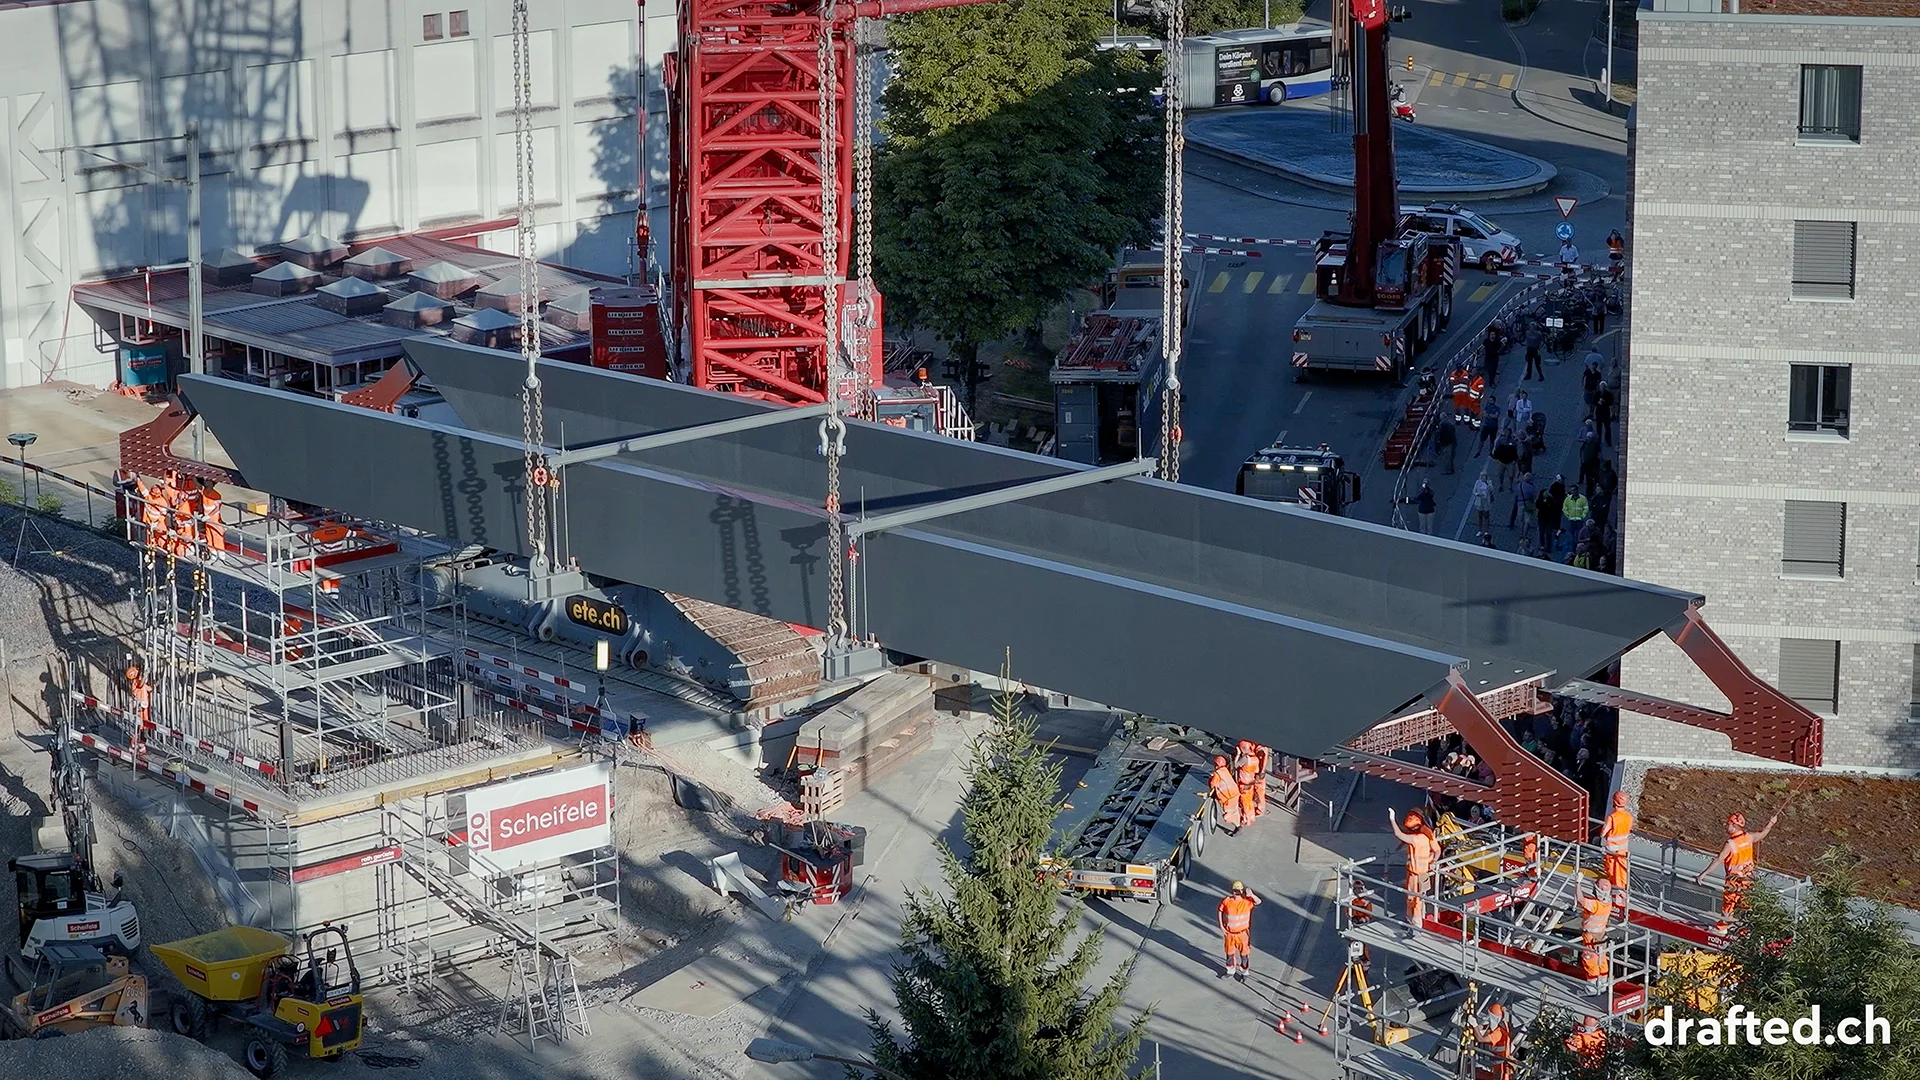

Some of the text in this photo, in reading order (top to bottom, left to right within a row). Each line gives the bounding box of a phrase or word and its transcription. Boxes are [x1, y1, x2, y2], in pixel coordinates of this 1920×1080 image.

[1218, 51, 1252, 61] Dein Körper
[1218, 58, 1258, 69] verdient mehr
[572, 600, 621, 631] ete.ch
[499, 800, 598, 839] Scheifele
[69, 923, 98, 932] Scheifele
[41, 1007, 69, 1023] Scheifele
